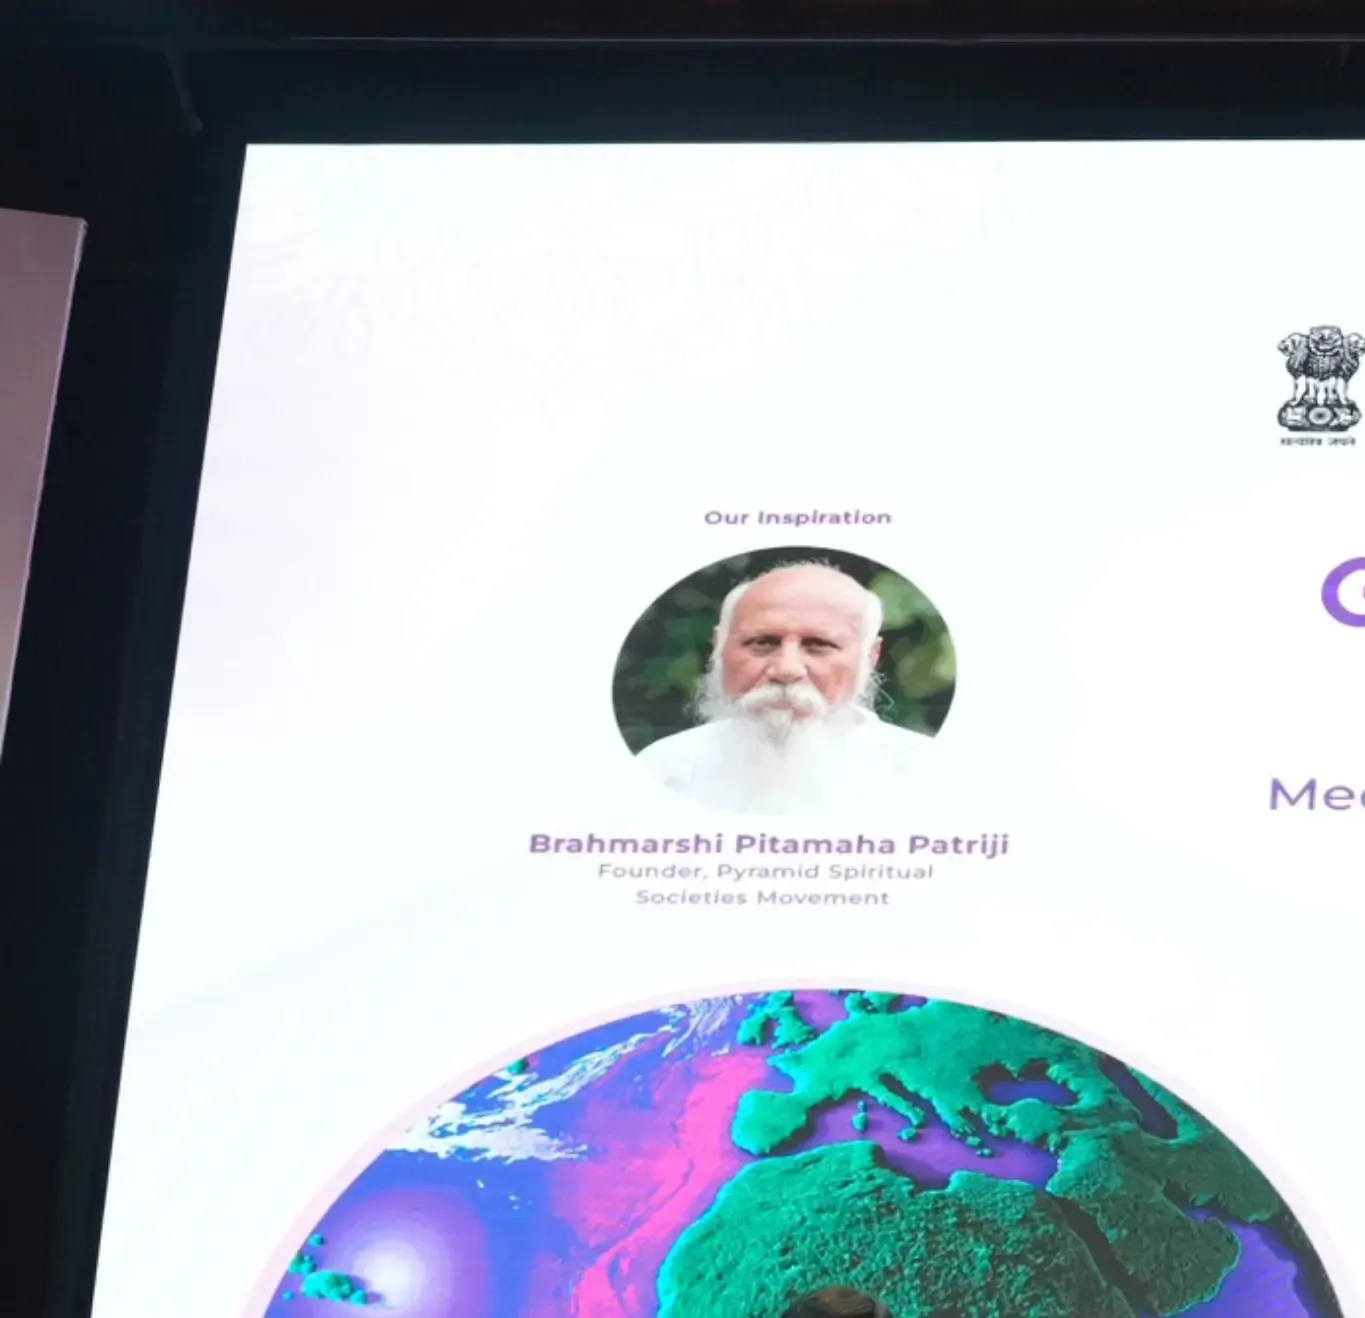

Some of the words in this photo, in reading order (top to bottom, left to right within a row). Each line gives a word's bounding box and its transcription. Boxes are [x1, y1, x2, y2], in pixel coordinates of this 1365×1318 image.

[703, 510, 751, 526] Our
[757, 508, 892, 528] Inspiration
[529, 832, 724, 855] Brahmarshi
[735, 832, 896, 855] Pitamaha
[908, 832, 1010, 860] Patriji
[597, 862, 708, 881] Founder,
[717, 863, 820, 883] Pyramid
[828, 863, 934, 882] Spiritual
[635, 889, 748, 906] Societies
[756, 889, 890, 906] Movement
